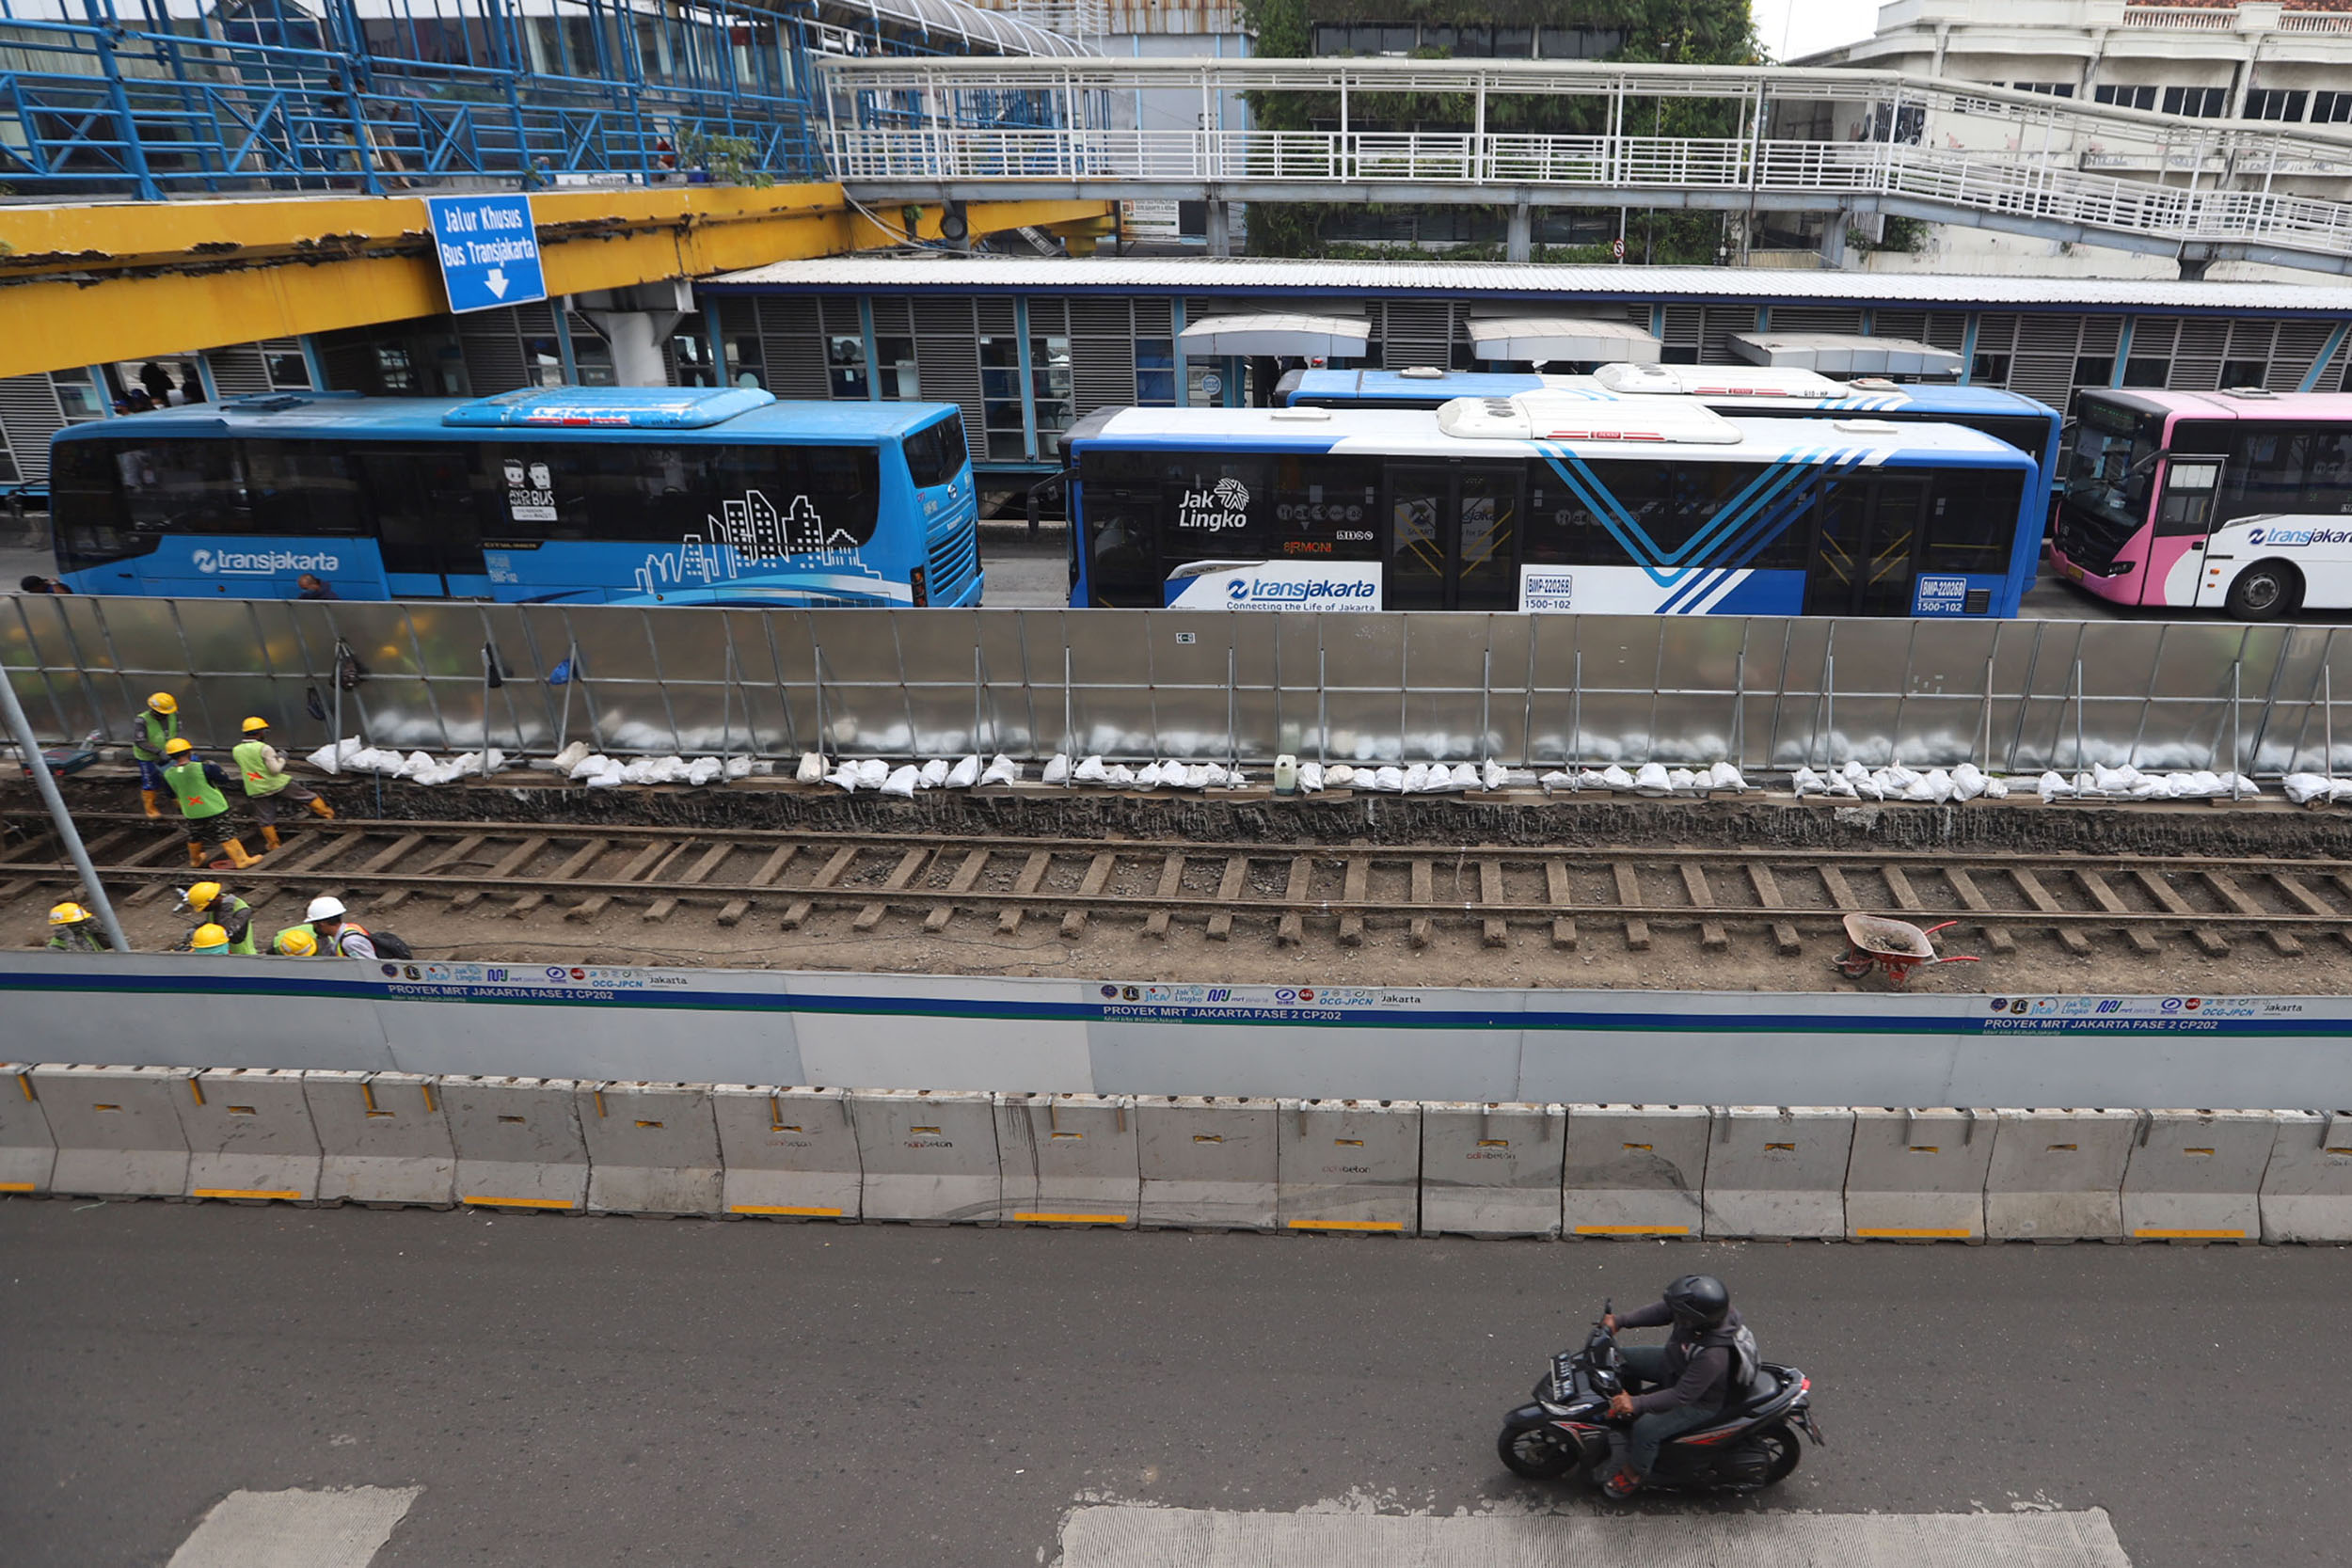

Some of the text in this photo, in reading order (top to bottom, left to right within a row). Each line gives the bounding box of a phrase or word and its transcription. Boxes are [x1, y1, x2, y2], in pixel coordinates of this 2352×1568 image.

[444, 205, 523, 232] Jalur Khusus
[440, 236, 535, 268] Bus Transjakarta
[531, 490, 556, 506] BUS
[1179, 489, 1215, 509] Jak
[1179, 509, 1248, 532] Lingko
[217, 549, 340, 575] transjakarta
[1251, 578, 1375, 602] transjakarta
[1227, 601, 1375, 611] Connecting the Life of Jakarta
[1525, 599, 1571, 610] 1500-102
[1917, 603, 1963, 612] 1500-102
[388, 985, 439, 995] PROYEK
[442, 986, 469, 996] MRT
[471, 988, 530, 998] JAKARTA
[531, 990, 564, 999] FASE
[576, 991, 614, 1000] CP202
[1104, 1006, 1157, 1015] PROYEK
[1161, 1008, 1188, 1017] MRT
[1192, 1008, 1250, 1018] JAKARTA
[1255, 1010, 1288, 1019] FASE
[1302, 1011, 1342, 1020] CP202
[1984, 1020, 2038, 1029] PROYEK
[2041, 1021, 2069, 1029] MRT
[2071, 1021, 2130, 1029] JAKARTA
[2132, 1021, 2166, 1029] FASE
[2179, 1021, 2218, 1029] CP202
